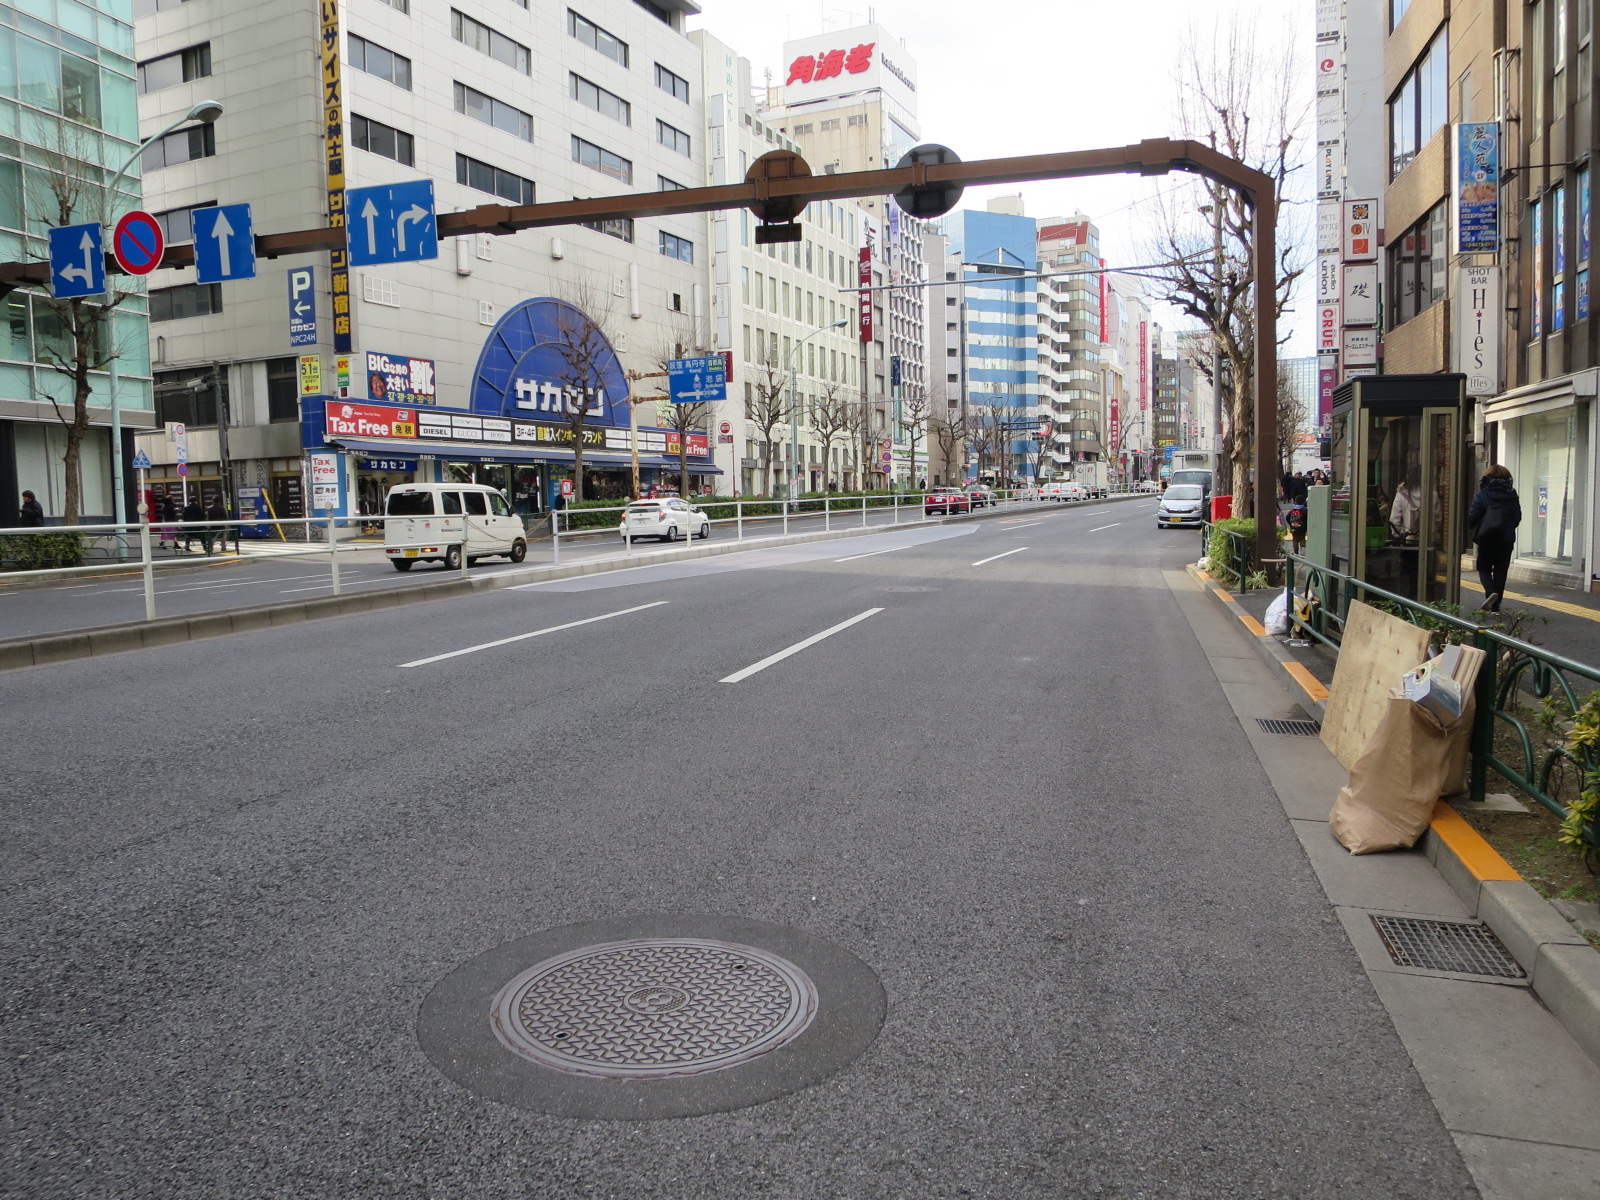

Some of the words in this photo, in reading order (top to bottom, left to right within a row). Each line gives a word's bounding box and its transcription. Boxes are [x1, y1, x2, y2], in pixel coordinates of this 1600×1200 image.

[786, 42, 875, 86] 角海老
[323, 0, 342, 175] いサイズの紳士服
[329, 192, 346, 269] サカン
[1318, 223, 1338, 231] OFFICE
[1321, 260, 1329, 295] union
[1467, 268, 1491, 276] SHOT
[292, 271, 311, 300] P
[332, 274, 349, 335] 新宿店
[291, 323, 315, 333] サカゼン
[1323, 309, 1334, 347] CRUE
[1472, 288, 1486, 369] Hies
[290, 334, 316, 344] NPC24H
[301, 363, 318, 376] 51台
[367, 354, 407, 374] BIGな男の
[386, 376, 409, 392] 大きい
[409, 359, 435, 395] 靴
[516, 377, 604, 417] サカゼン
[329, 416, 356, 434] Tax
[358, 419, 389, 435] Free
[394, 424, 412, 435] 免税
[457, 429, 477, 438] GUCCI
[537, 426, 603, 444] 直輸入インポーブランド
[693, 444, 708, 455] Free
[313, 458, 330, 466] Tax
[370, 460, 406, 469] サカゼン
